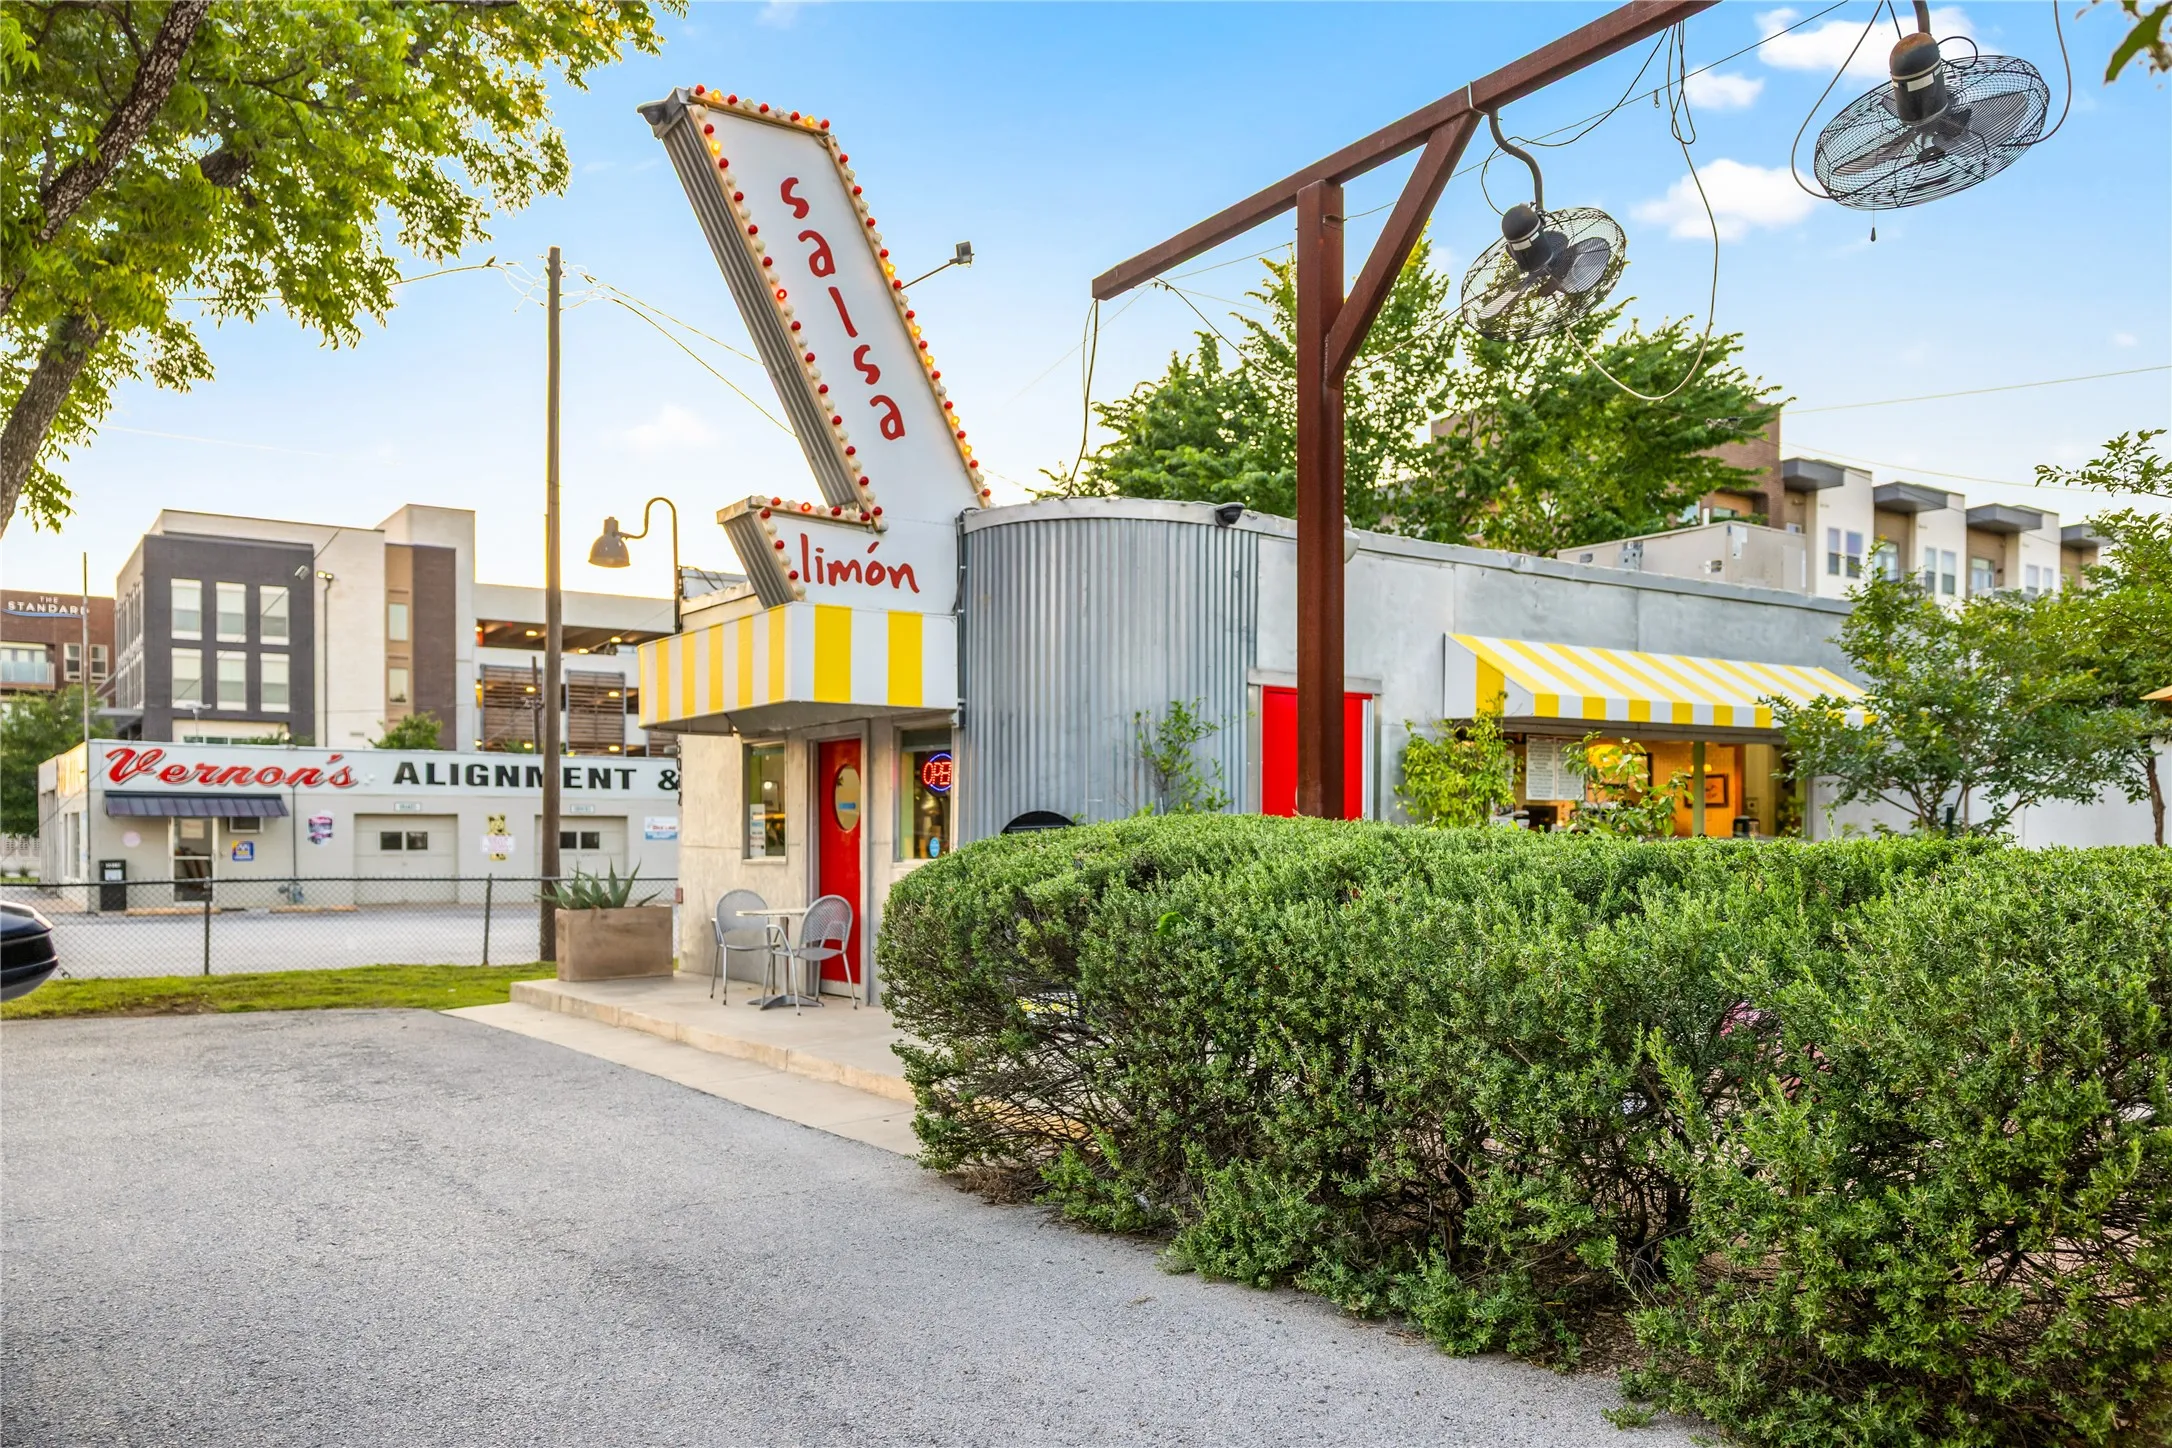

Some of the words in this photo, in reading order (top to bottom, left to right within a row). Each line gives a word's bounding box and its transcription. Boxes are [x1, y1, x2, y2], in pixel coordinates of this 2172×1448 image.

[780, 177, 906, 441] salsa
[799, 532, 920, 594] limón
[40, 595, 59, 603] THE
[105, 747, 358, 787] Vernon's
[658, 769, 679, 790] &
[923, 761, 952, 785] OPE
